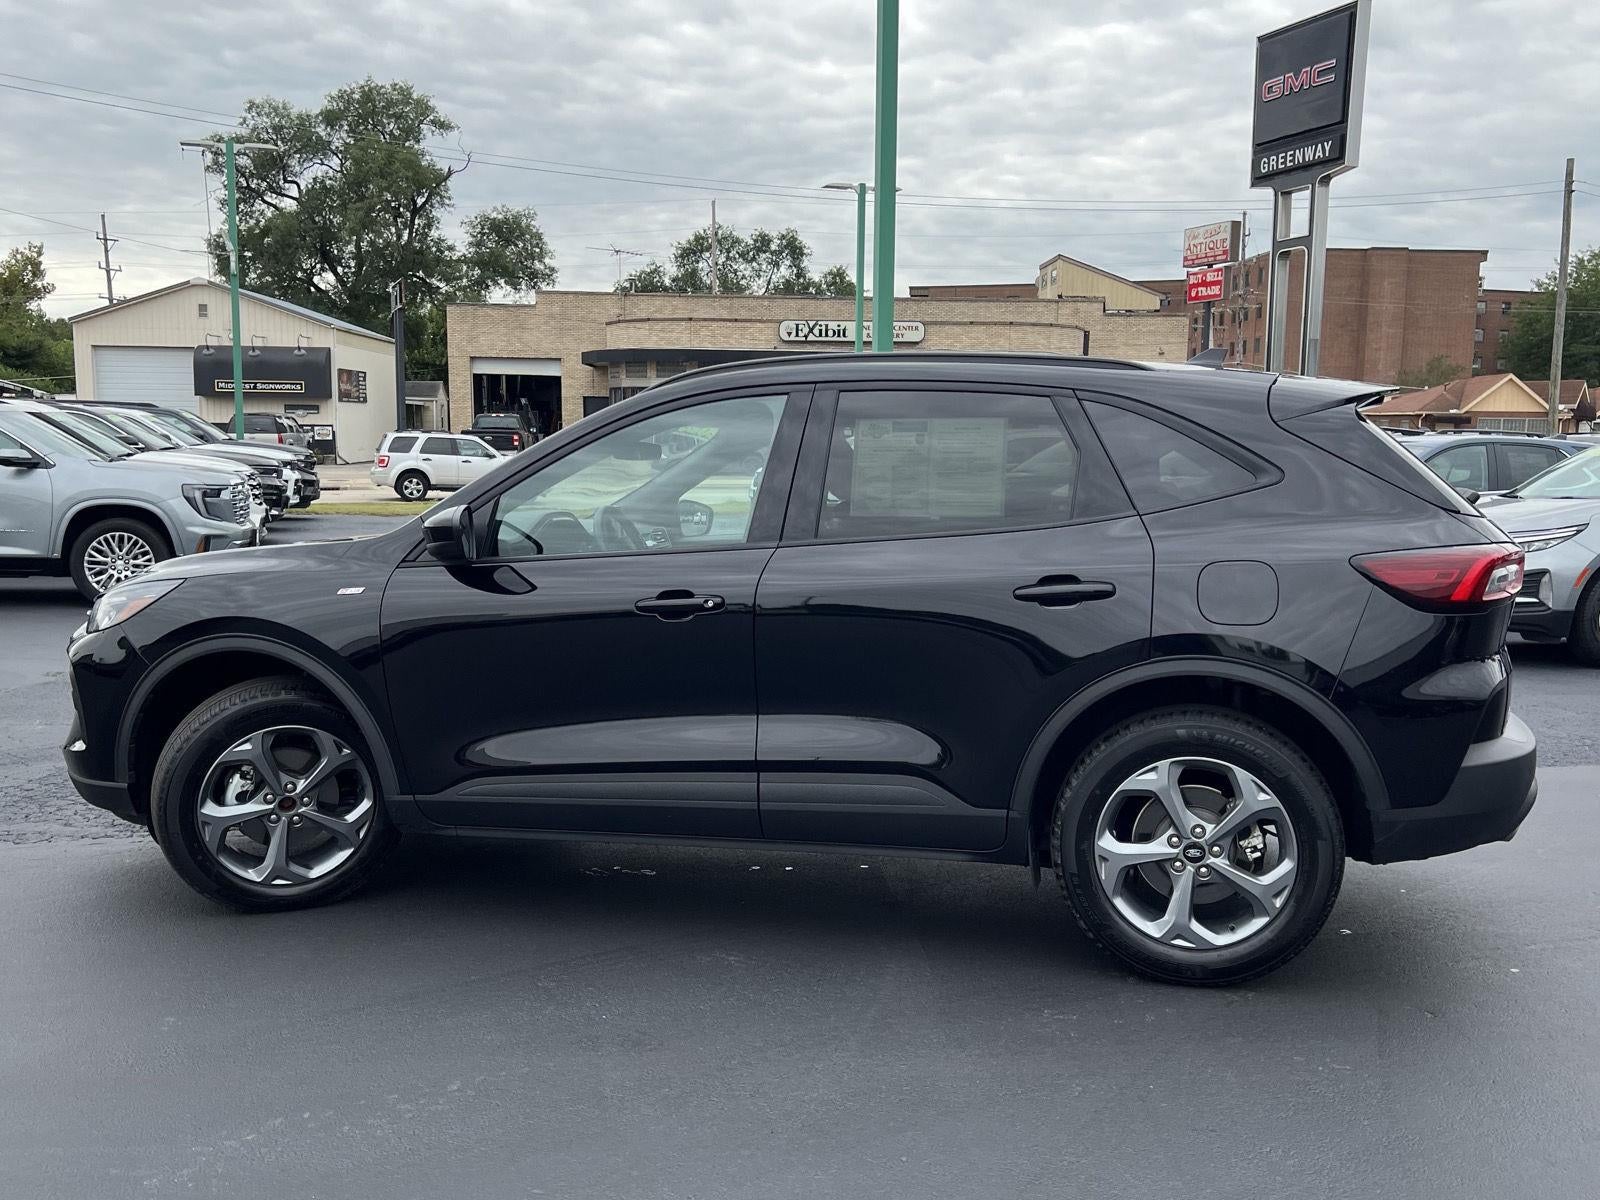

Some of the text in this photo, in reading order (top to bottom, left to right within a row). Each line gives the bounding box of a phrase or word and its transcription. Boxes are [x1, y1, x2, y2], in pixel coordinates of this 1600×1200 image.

[1261, 58, 1337, 102] GMC
[1260, 140, 1333, 174] GREENWAY
[1186, 238, 1228, 254] ANTIQUE
[1189, 271, 1223, 284] BUY SELL
[1197, 285, 1221, 296] TRADE
[256, 382, 301, 390] SIGNWORKS
